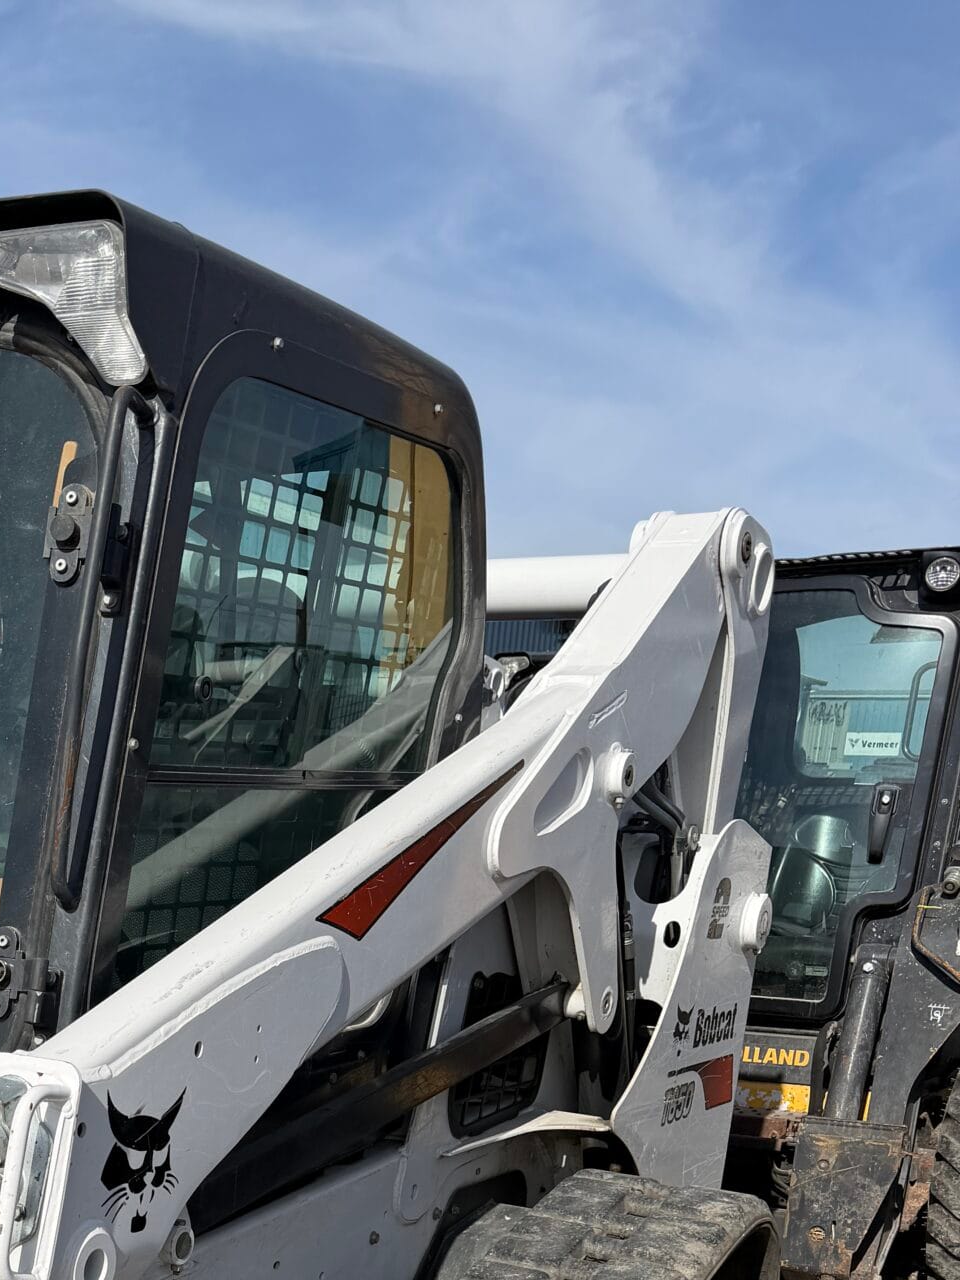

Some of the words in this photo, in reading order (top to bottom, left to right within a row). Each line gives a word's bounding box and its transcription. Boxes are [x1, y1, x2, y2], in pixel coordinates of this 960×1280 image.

[861, 739, 899, 750] Vermeer
[692, 1003, 738, 1049] Bobcat
[742, 1045, 810, 1068] LLAND
